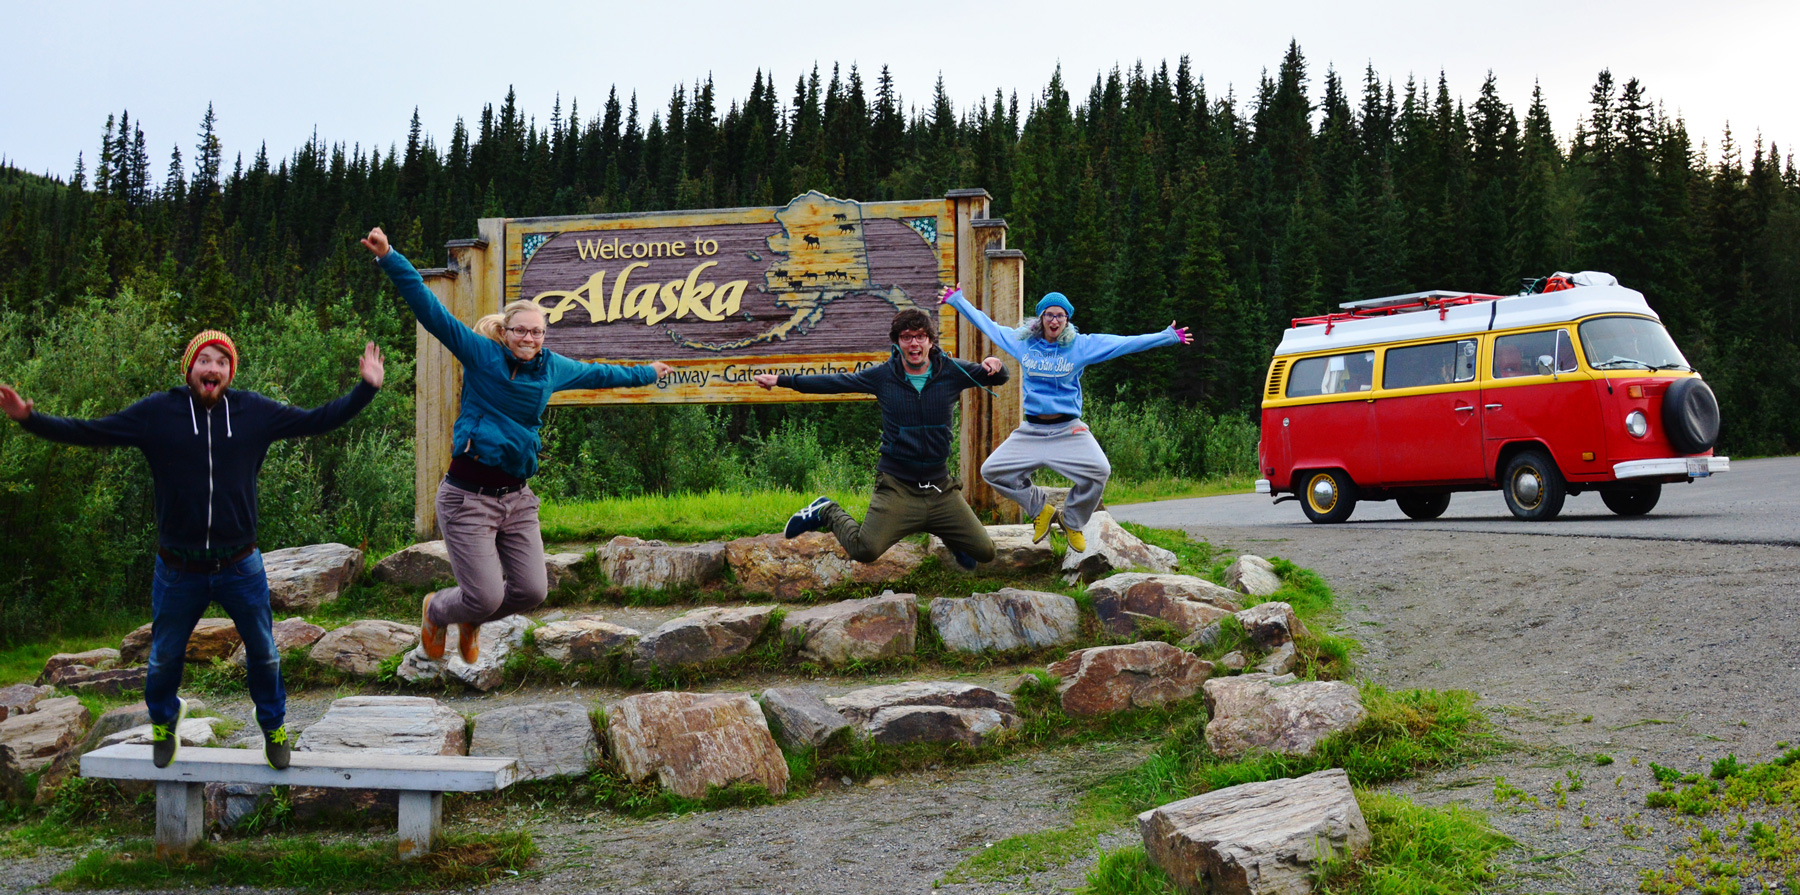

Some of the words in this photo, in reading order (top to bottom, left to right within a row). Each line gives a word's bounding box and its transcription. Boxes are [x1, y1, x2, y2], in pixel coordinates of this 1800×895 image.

[576, 238, 686, 260] Welcome
[694, 236, 718, 256] to
[533, 261, 749, 326] Alaska
[1022, 352, 1038, 373] Cape
[1055, 357, 1074, 372] Blas
[653, 370, 709, 389] ghway
